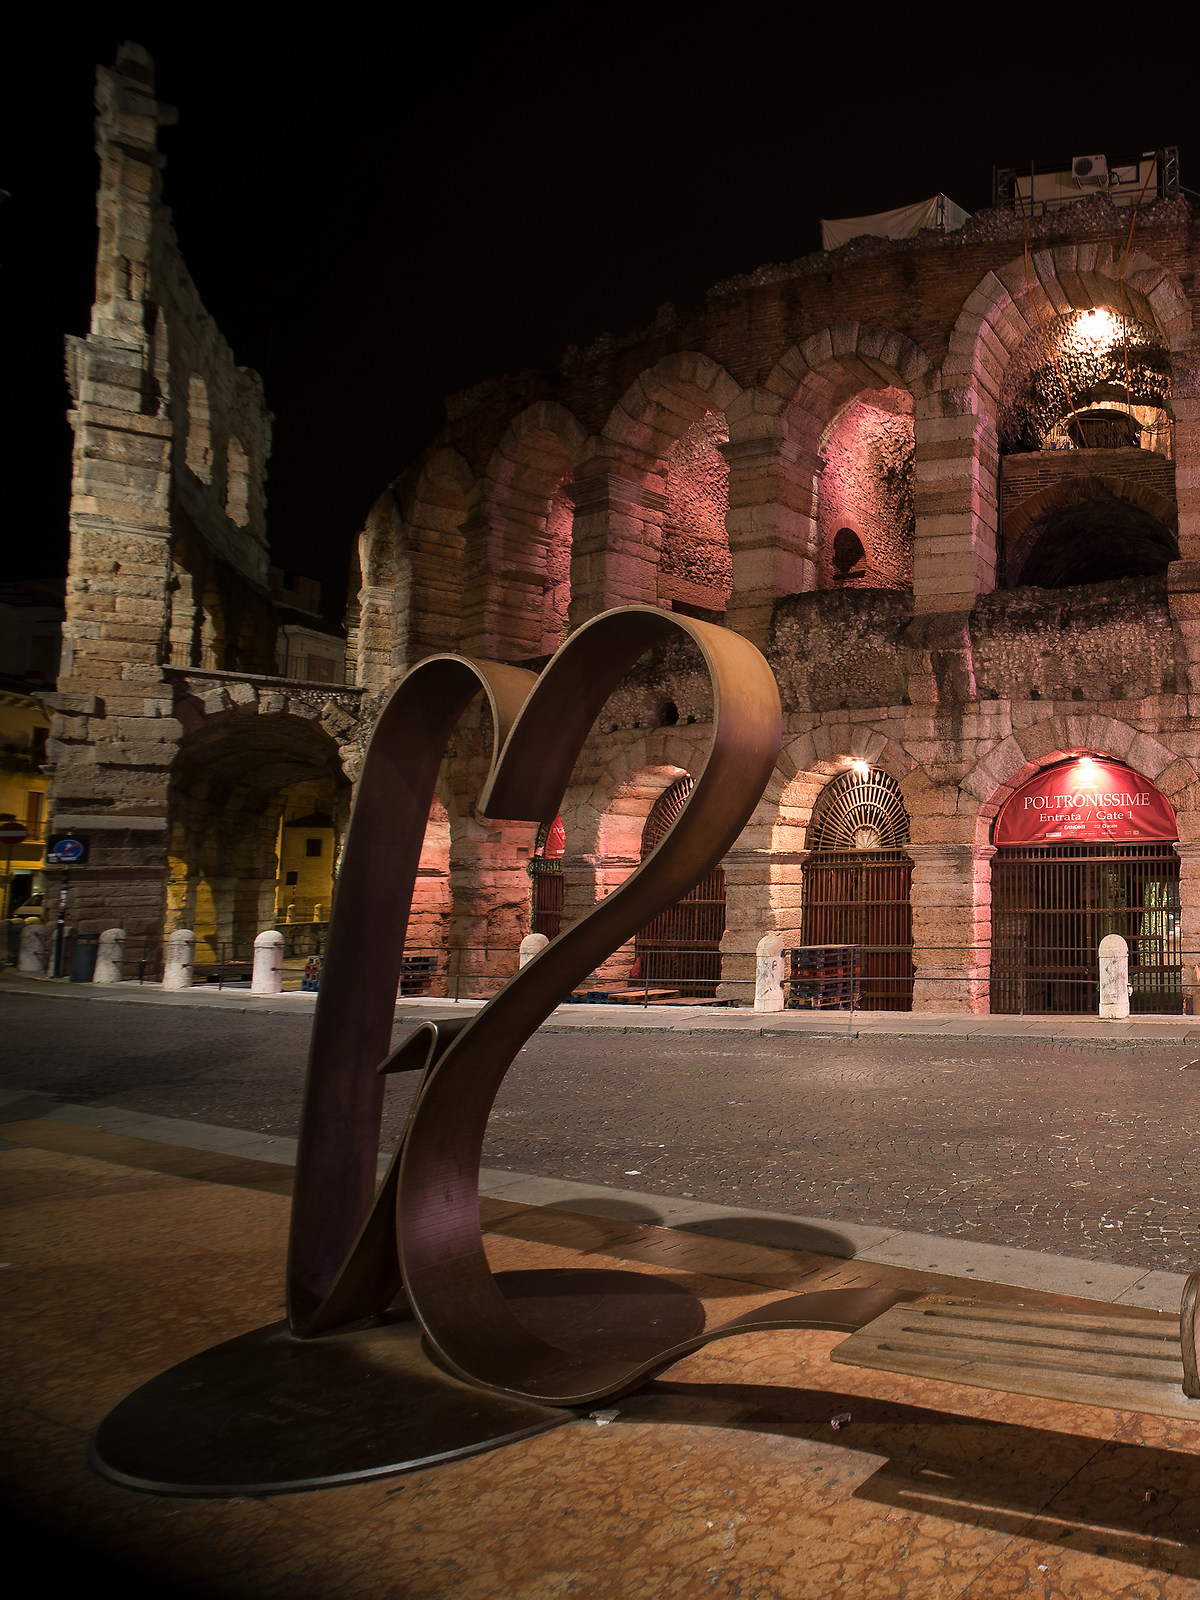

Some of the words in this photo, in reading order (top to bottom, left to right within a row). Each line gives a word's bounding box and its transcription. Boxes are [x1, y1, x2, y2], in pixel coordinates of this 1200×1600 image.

[1023, 793, 1150, 810] POLTRONISSIME
[1040, 813, 1081, 822] Entrata
[1086, 811, 1092, 821] /
[1096, 810, 1124, 820] Gate
[1128, 810, 1133, 819] 1
